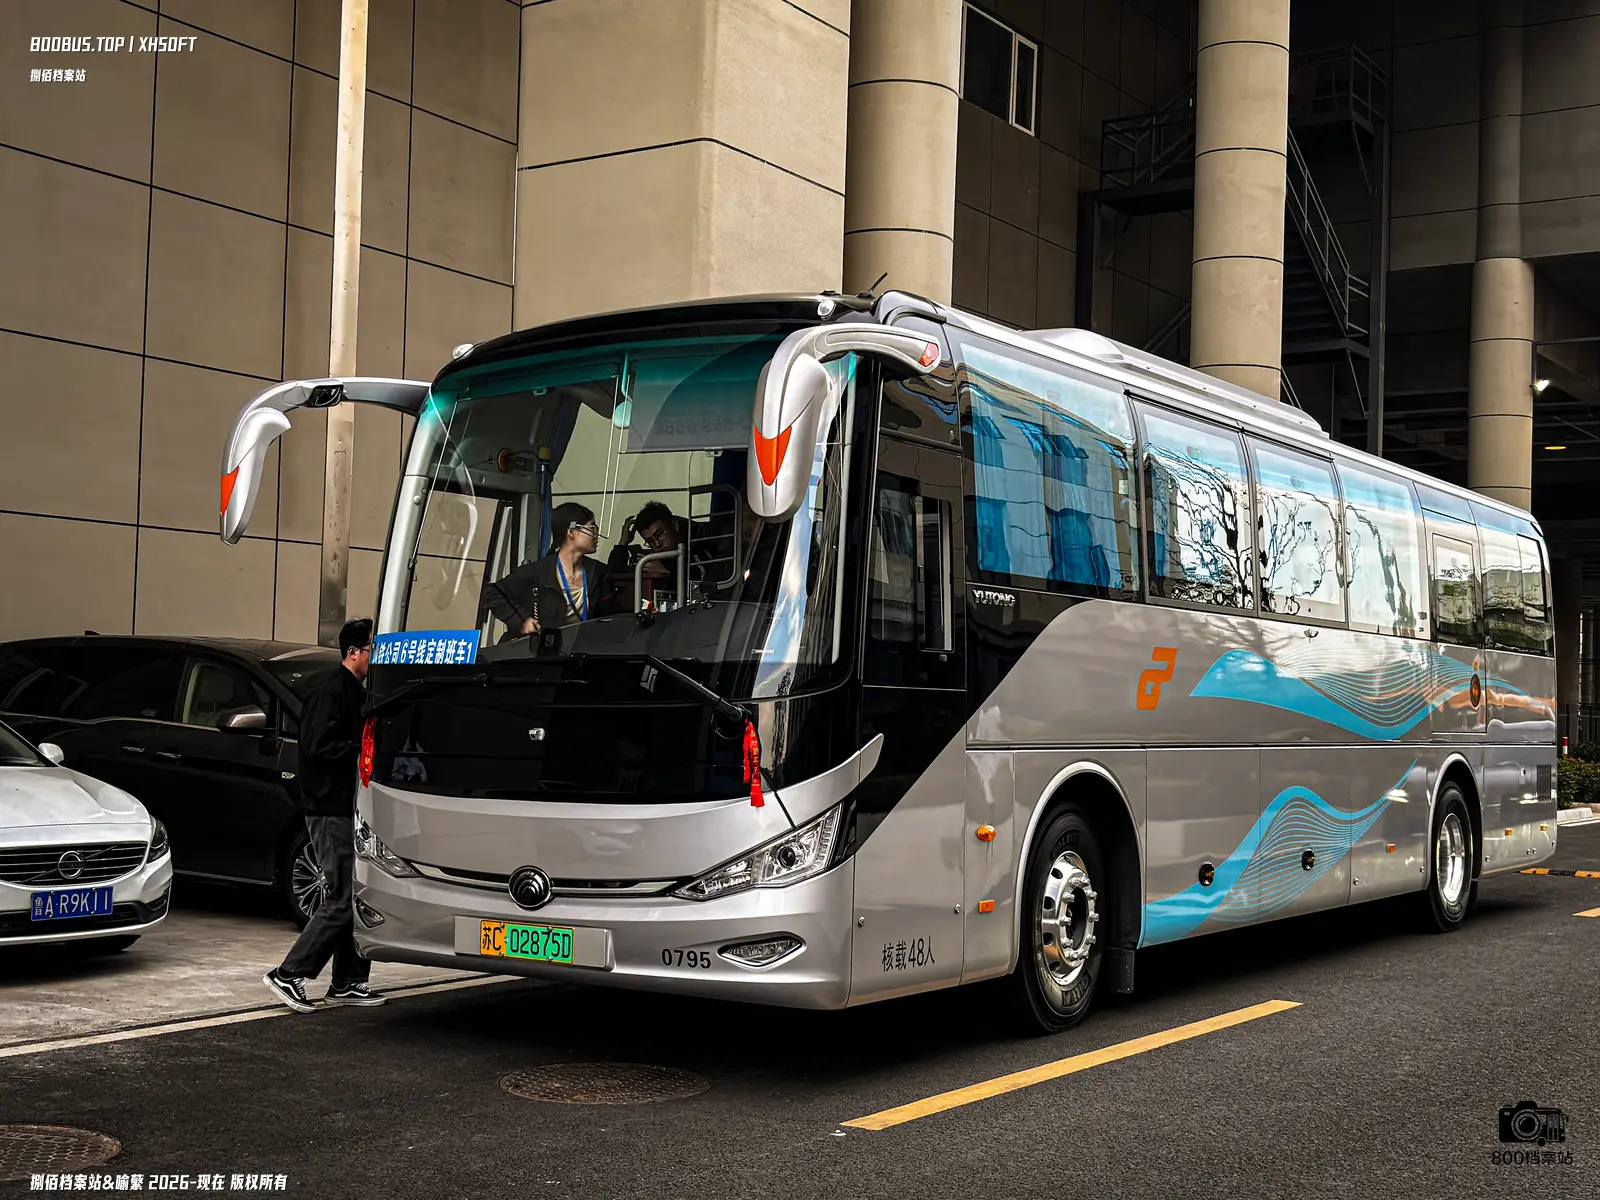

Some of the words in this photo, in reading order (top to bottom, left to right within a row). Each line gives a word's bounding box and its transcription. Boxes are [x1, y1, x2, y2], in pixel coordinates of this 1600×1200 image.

[972, 589, 1016, 607] YUTONG
[661, 948, 712, 969] 0795
[882, 936, 935, 972] 核载48人
